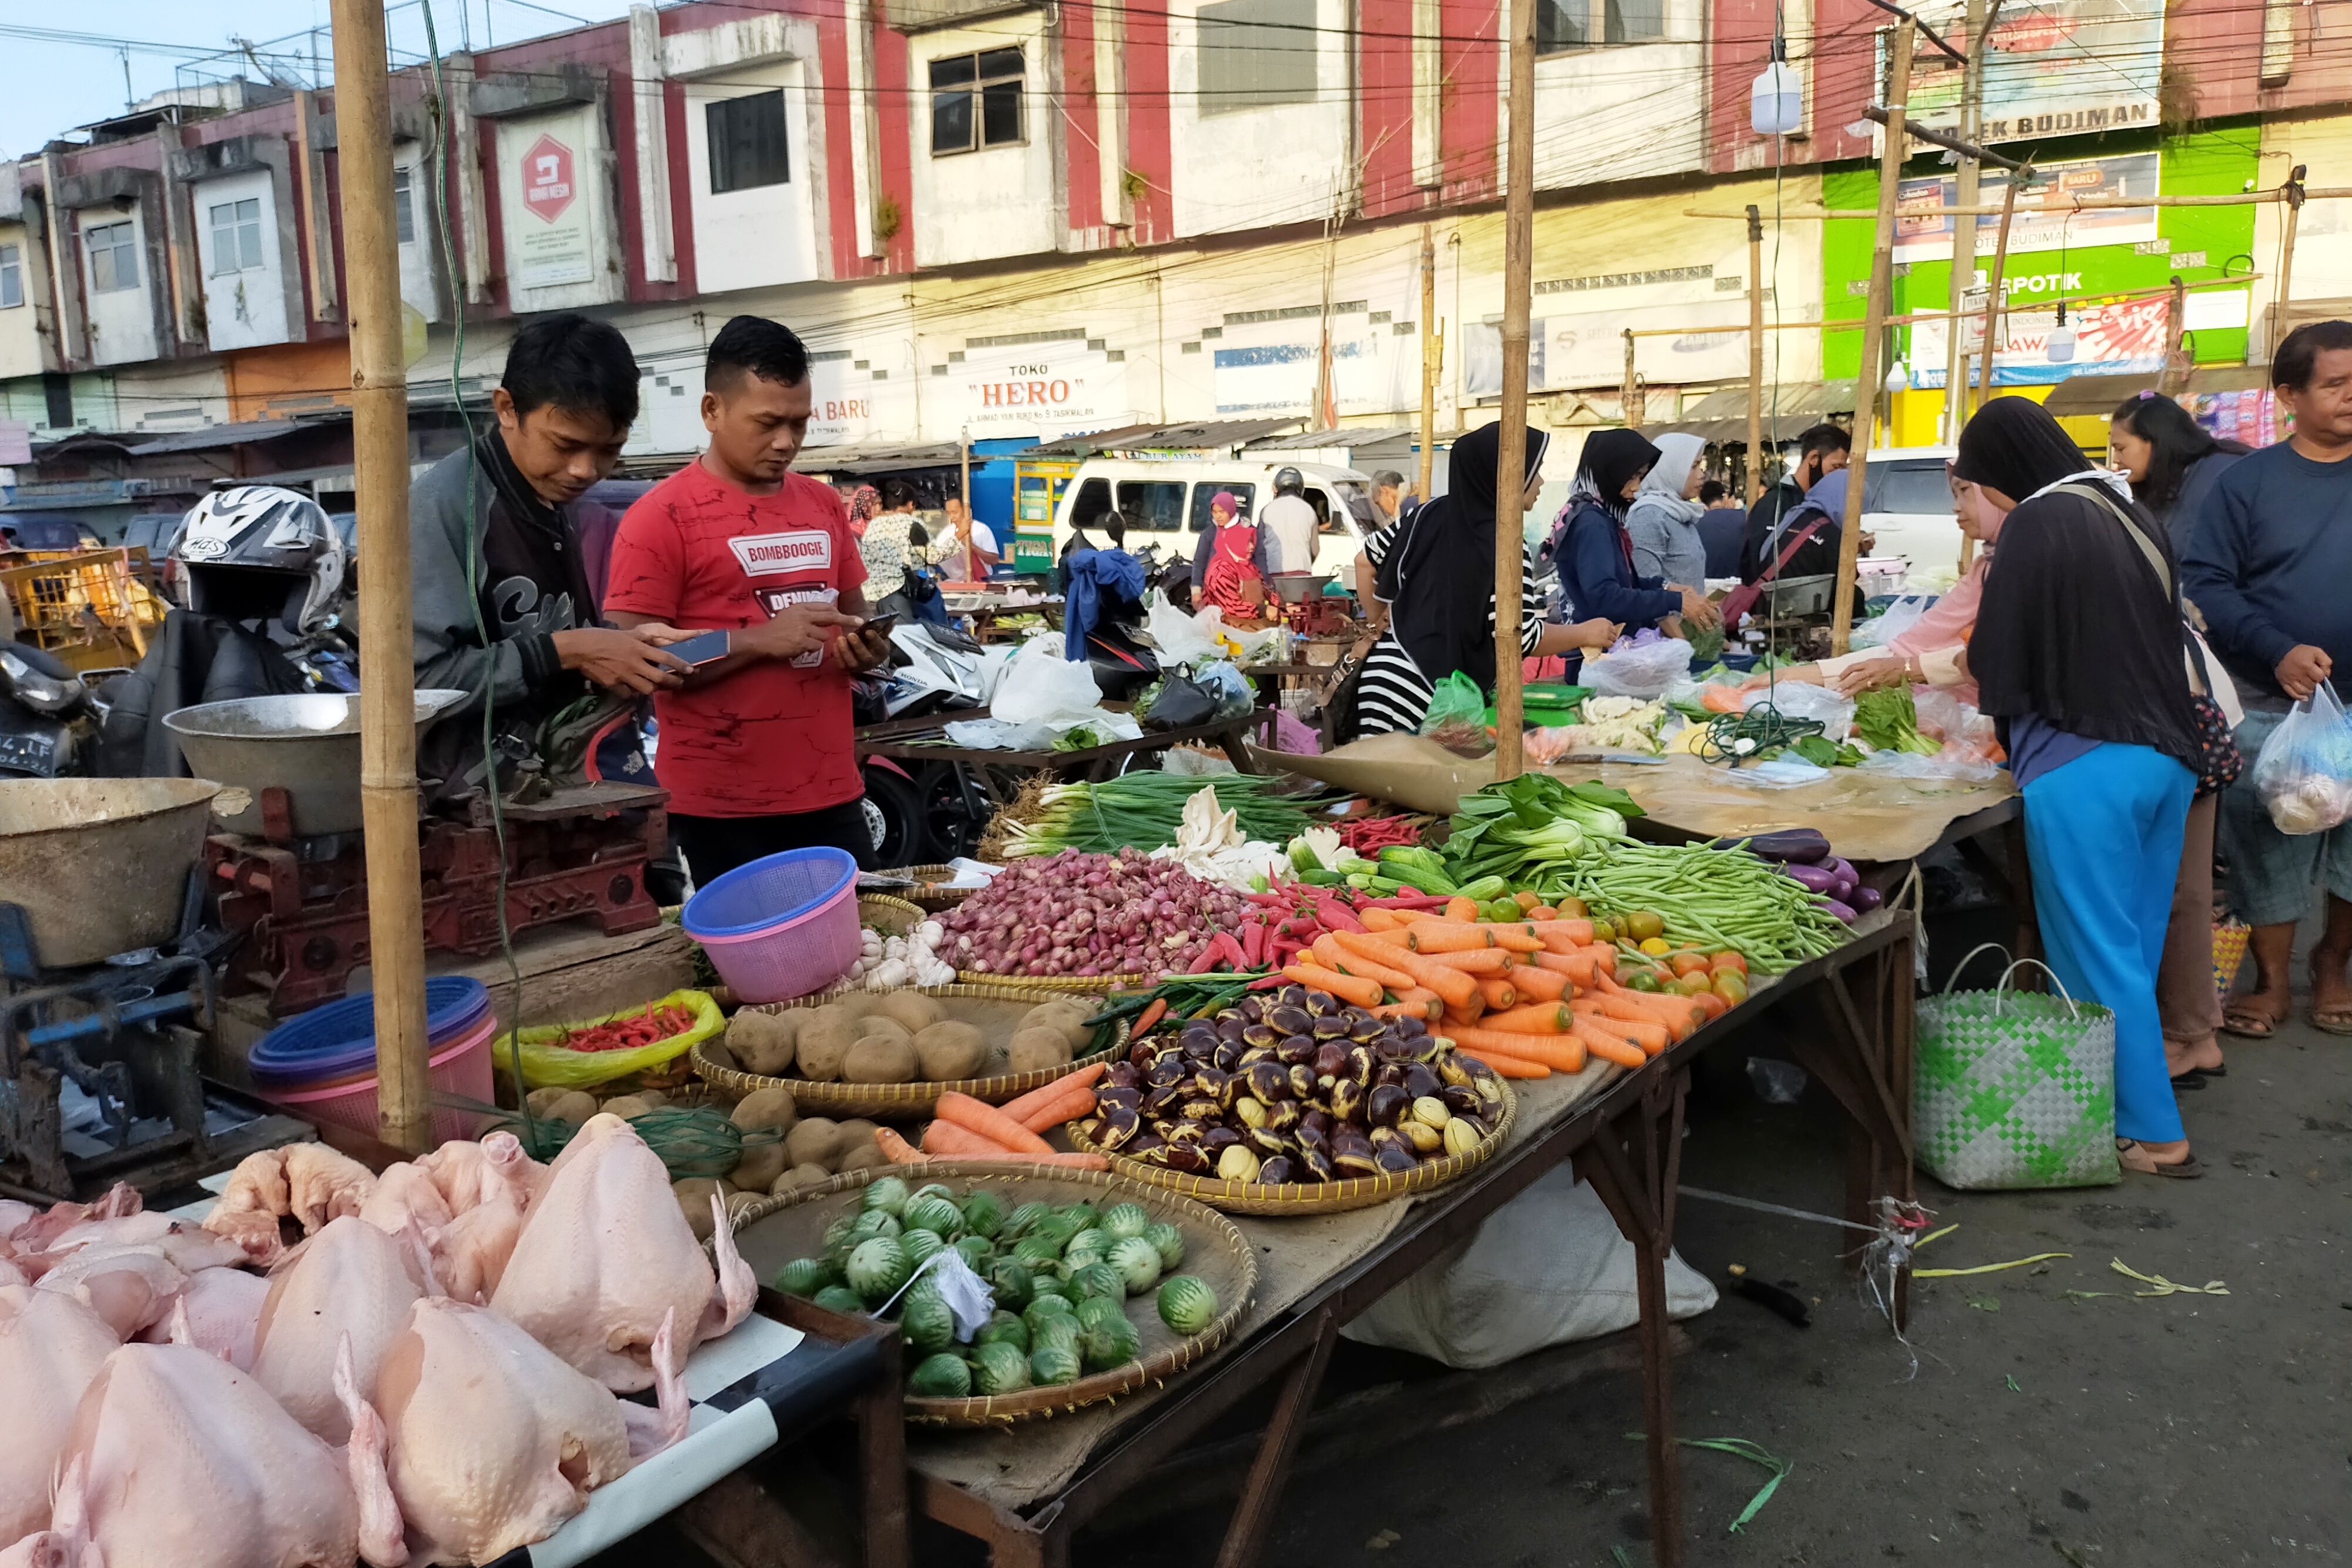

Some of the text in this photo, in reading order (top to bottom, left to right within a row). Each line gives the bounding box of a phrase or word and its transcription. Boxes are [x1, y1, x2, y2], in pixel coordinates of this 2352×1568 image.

[2017, 104, 2148, 134] BUDIMAN
[2010, 230, 2073, 246] BUDIMAN
[1010, 363, 1048, 376] TOKO
[826, 399, 870, 421] BARU
[977, 413, 998, 422] AHMAD
[1053, 408, 1095, 418] TASIKMALAYA
[1172, 452, 1202, 461] AYAM
[748, 541, 825, 562] BOMBBOOGIE
[1016, 540, 1050, 557] TIGA
[769, 590, 817, 611] DENI
[900, 672, 928, 686] HONDA
